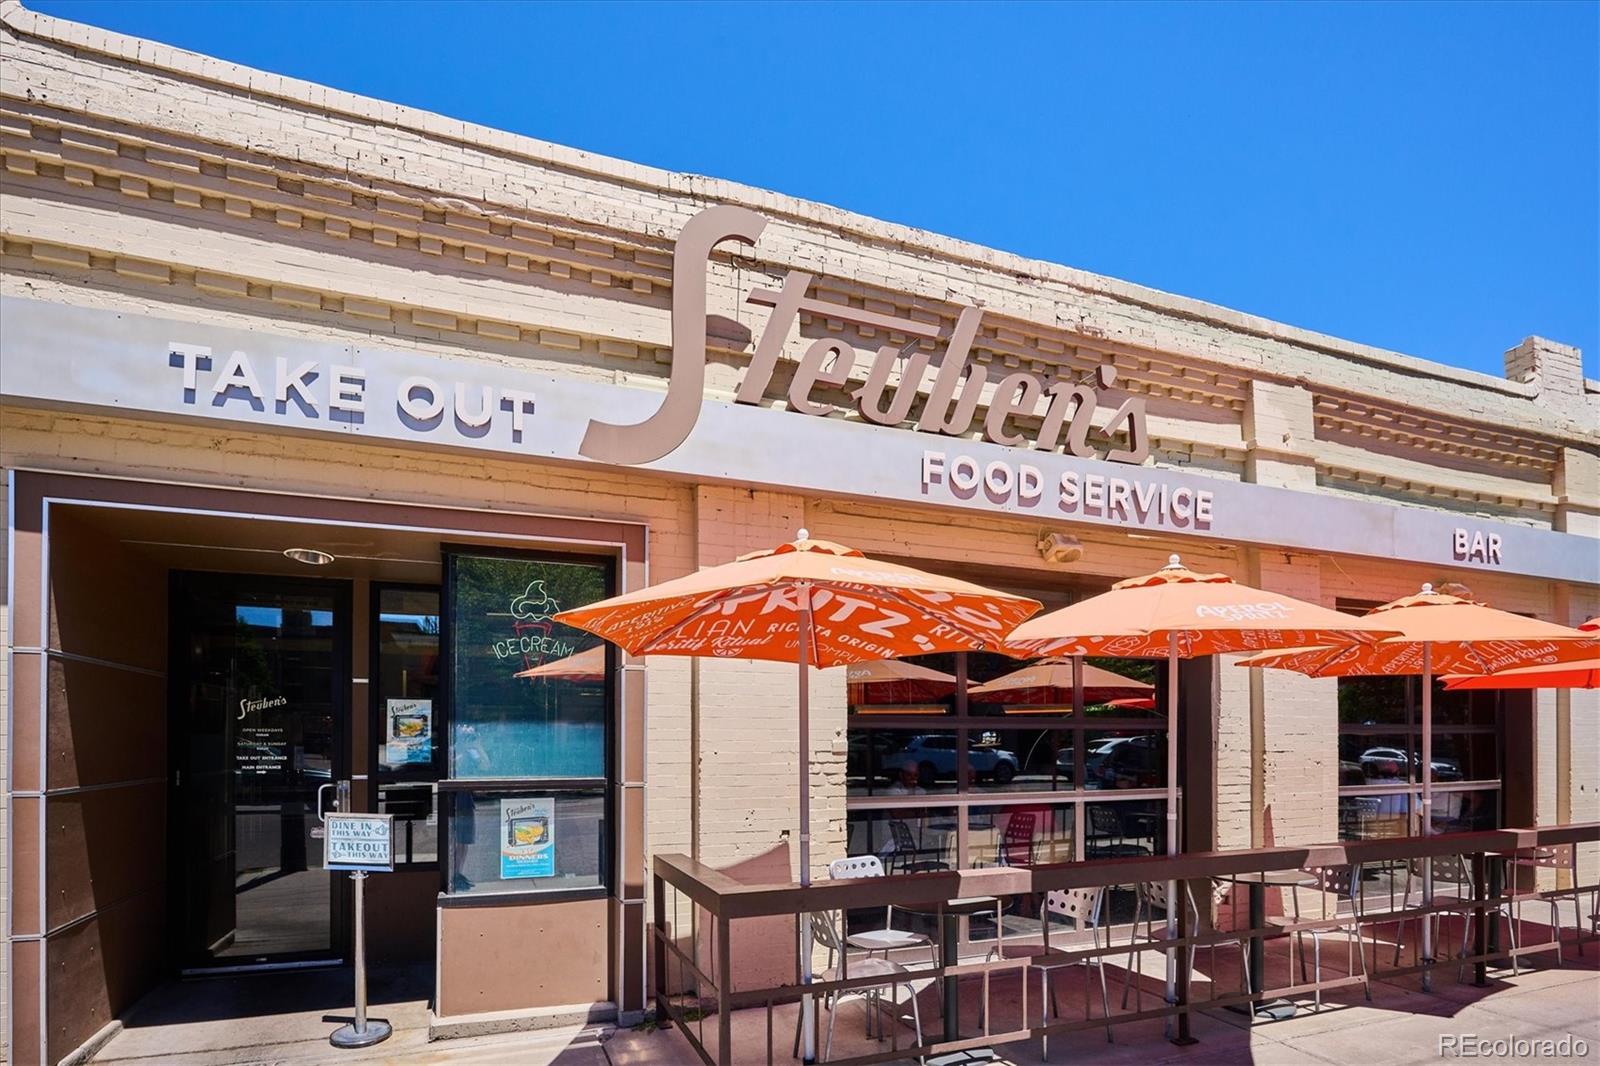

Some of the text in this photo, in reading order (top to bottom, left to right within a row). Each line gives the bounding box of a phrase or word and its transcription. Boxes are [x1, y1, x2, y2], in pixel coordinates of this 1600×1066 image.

[579, 205, 1150, 466] Steuben's
[168, 341, 536, 438] TAKE OUT
[922, 450, 1214, 526] FOOD SERVICE
[1453, 527, 1503, 562] BAR
[1195, 601, 1295, 618] APEROL
[492, 635, 575, 661] ICE CREAM
[237, 695, 287, 720] Steuben's
[331, 821, 372, 830] DINE IN
[331, 842, 389, 851] TAKEOUT
